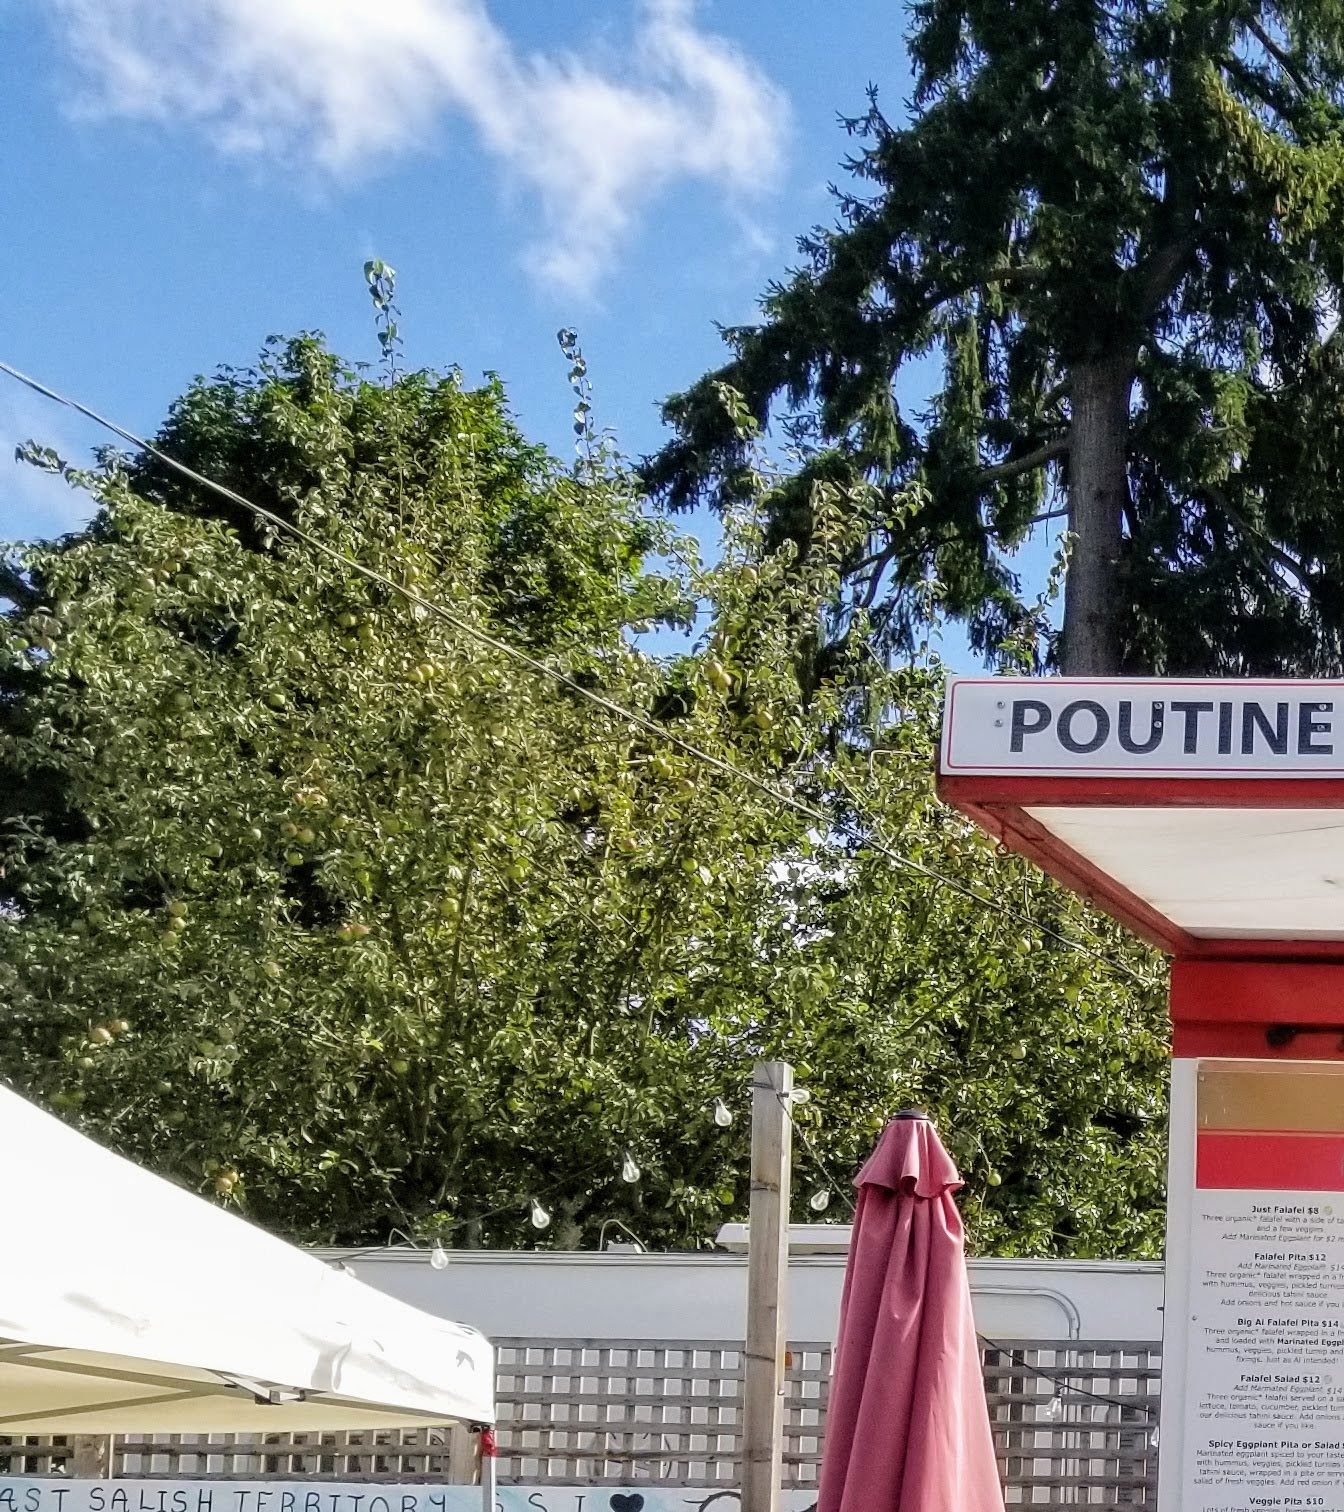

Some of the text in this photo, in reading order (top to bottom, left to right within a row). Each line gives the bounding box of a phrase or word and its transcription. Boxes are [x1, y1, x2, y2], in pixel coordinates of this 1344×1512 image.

[1010, 700, 1332, 755] POUTINE
[1252, 1205, 1318, 1215] Just Falafel $8
[1254, 1253, 1284, 1261] Falafel
[1308, 1253, 1325, 1261] $12
[1238, 1318, 1251, 1327] Big
[1268, 1318, 1297, 1327] Falafel
[1301, 1319, 1318, 1327] Pita
[1322, 1320, 1338, 1328] $14
[1240, 1374, 1319, 1384] Falafel Salad $12
[1208, 1440, 1233, 1450] Spicy
[1236, 1440, 1277, 1450] Eggplant
[1281, 1441, 1298, 1449] Pita
[1314, 1441, 1339, 1449] Salad
[1249, 1497, 1280, 1507] Veggie
[1306, 1497, 1323, 1505] $10
